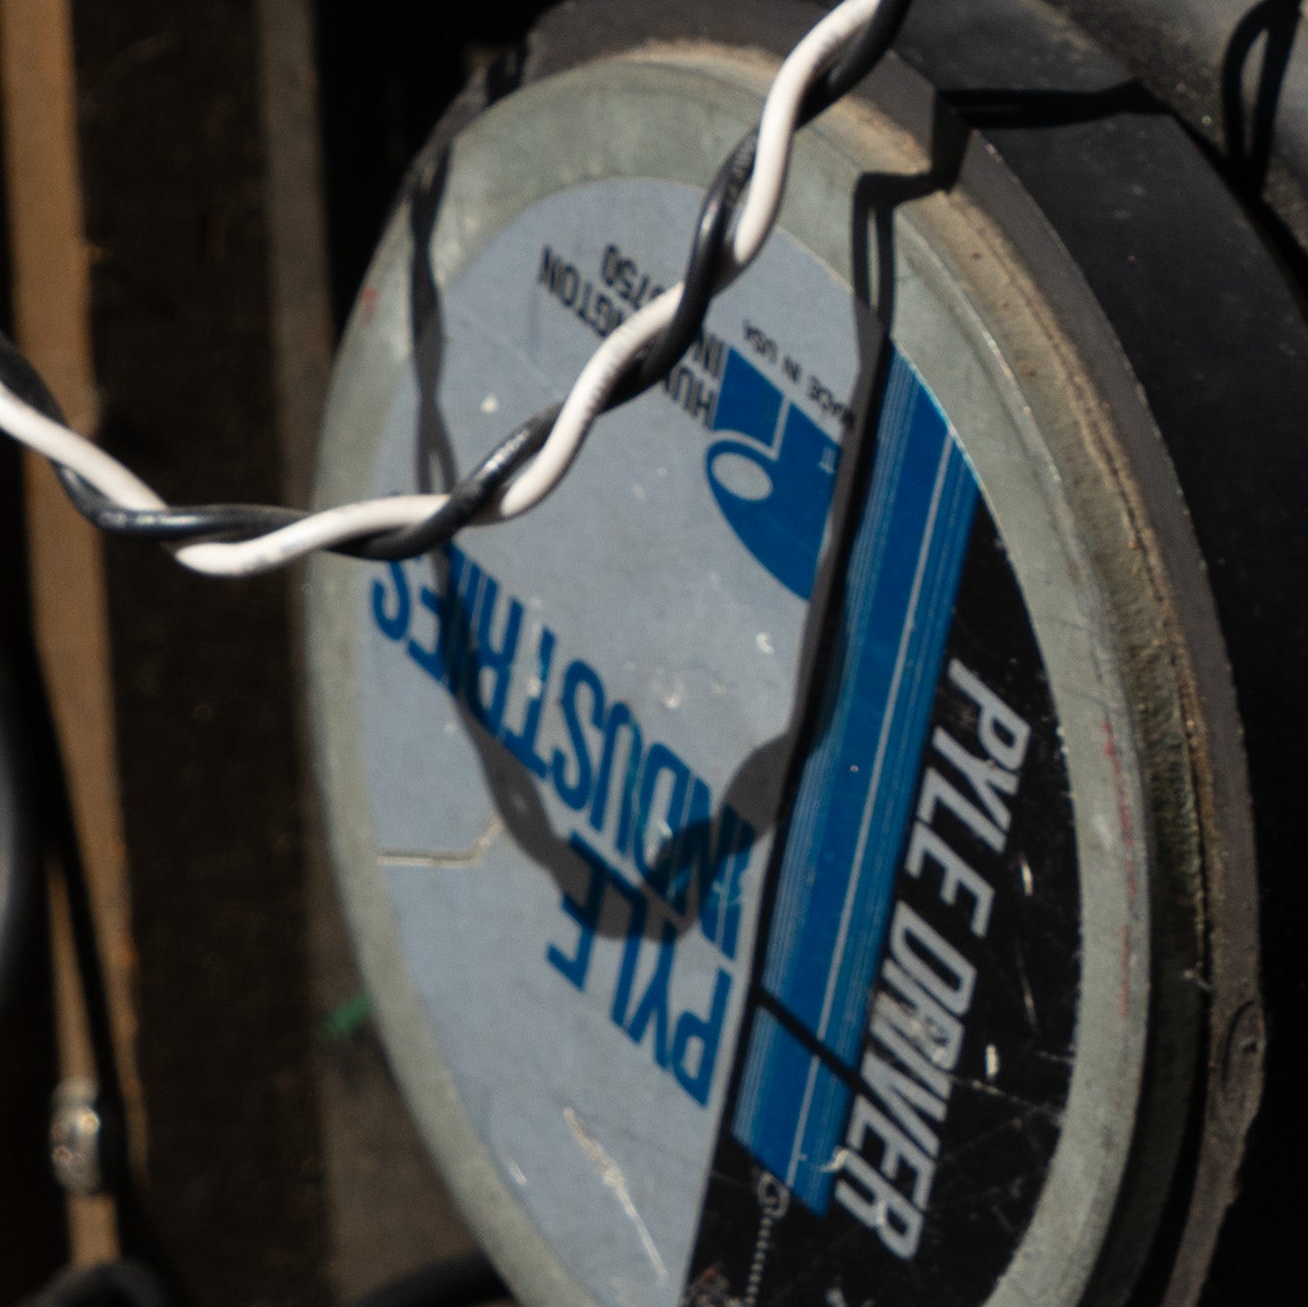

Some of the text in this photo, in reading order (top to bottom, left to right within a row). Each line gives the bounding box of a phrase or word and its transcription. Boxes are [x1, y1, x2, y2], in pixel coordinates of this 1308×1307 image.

[369, 545, 756, 961] INDUSTRIES
[832, 656, 1033, 1261] PYLE DRIVER
[545, 831, 735, 1107] PYLE
